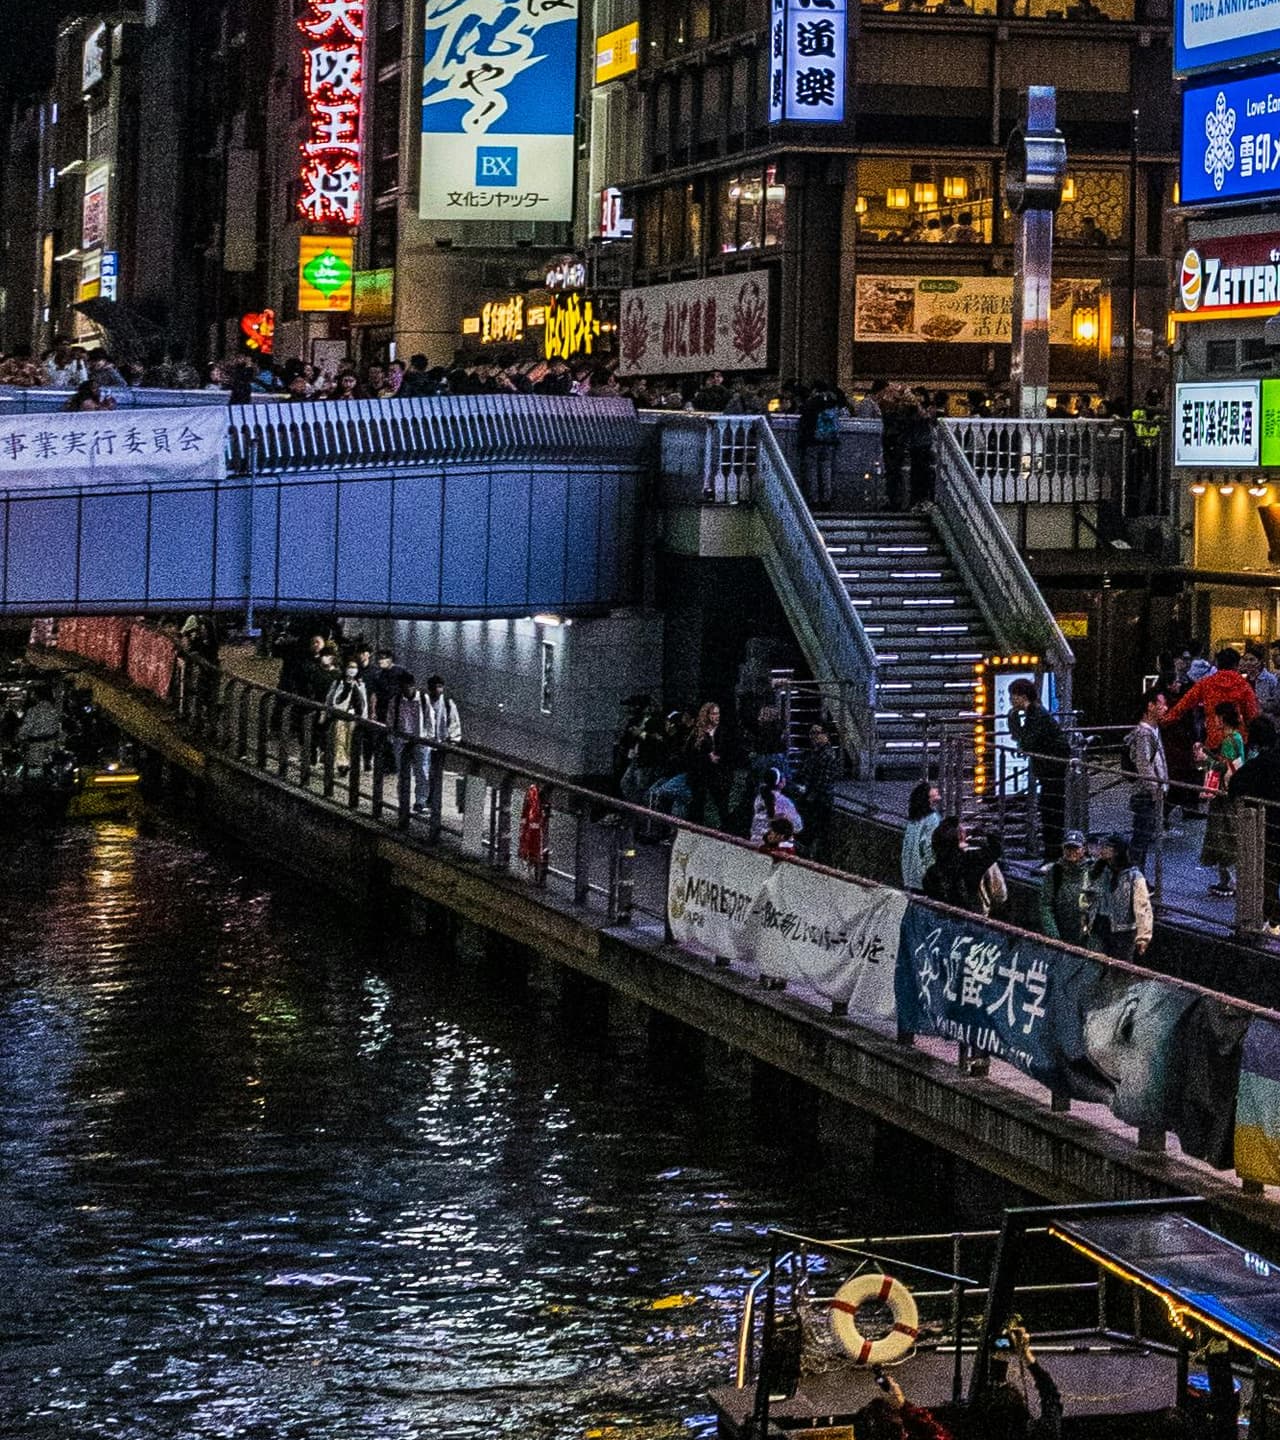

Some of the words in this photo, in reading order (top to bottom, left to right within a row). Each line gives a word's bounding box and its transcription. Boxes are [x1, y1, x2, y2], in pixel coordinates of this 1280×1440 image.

[1246, 98, 1266, 117] Love
[482, 154, 513, 177] BX
[0, 426, 204, 460] 事業実行委員会
